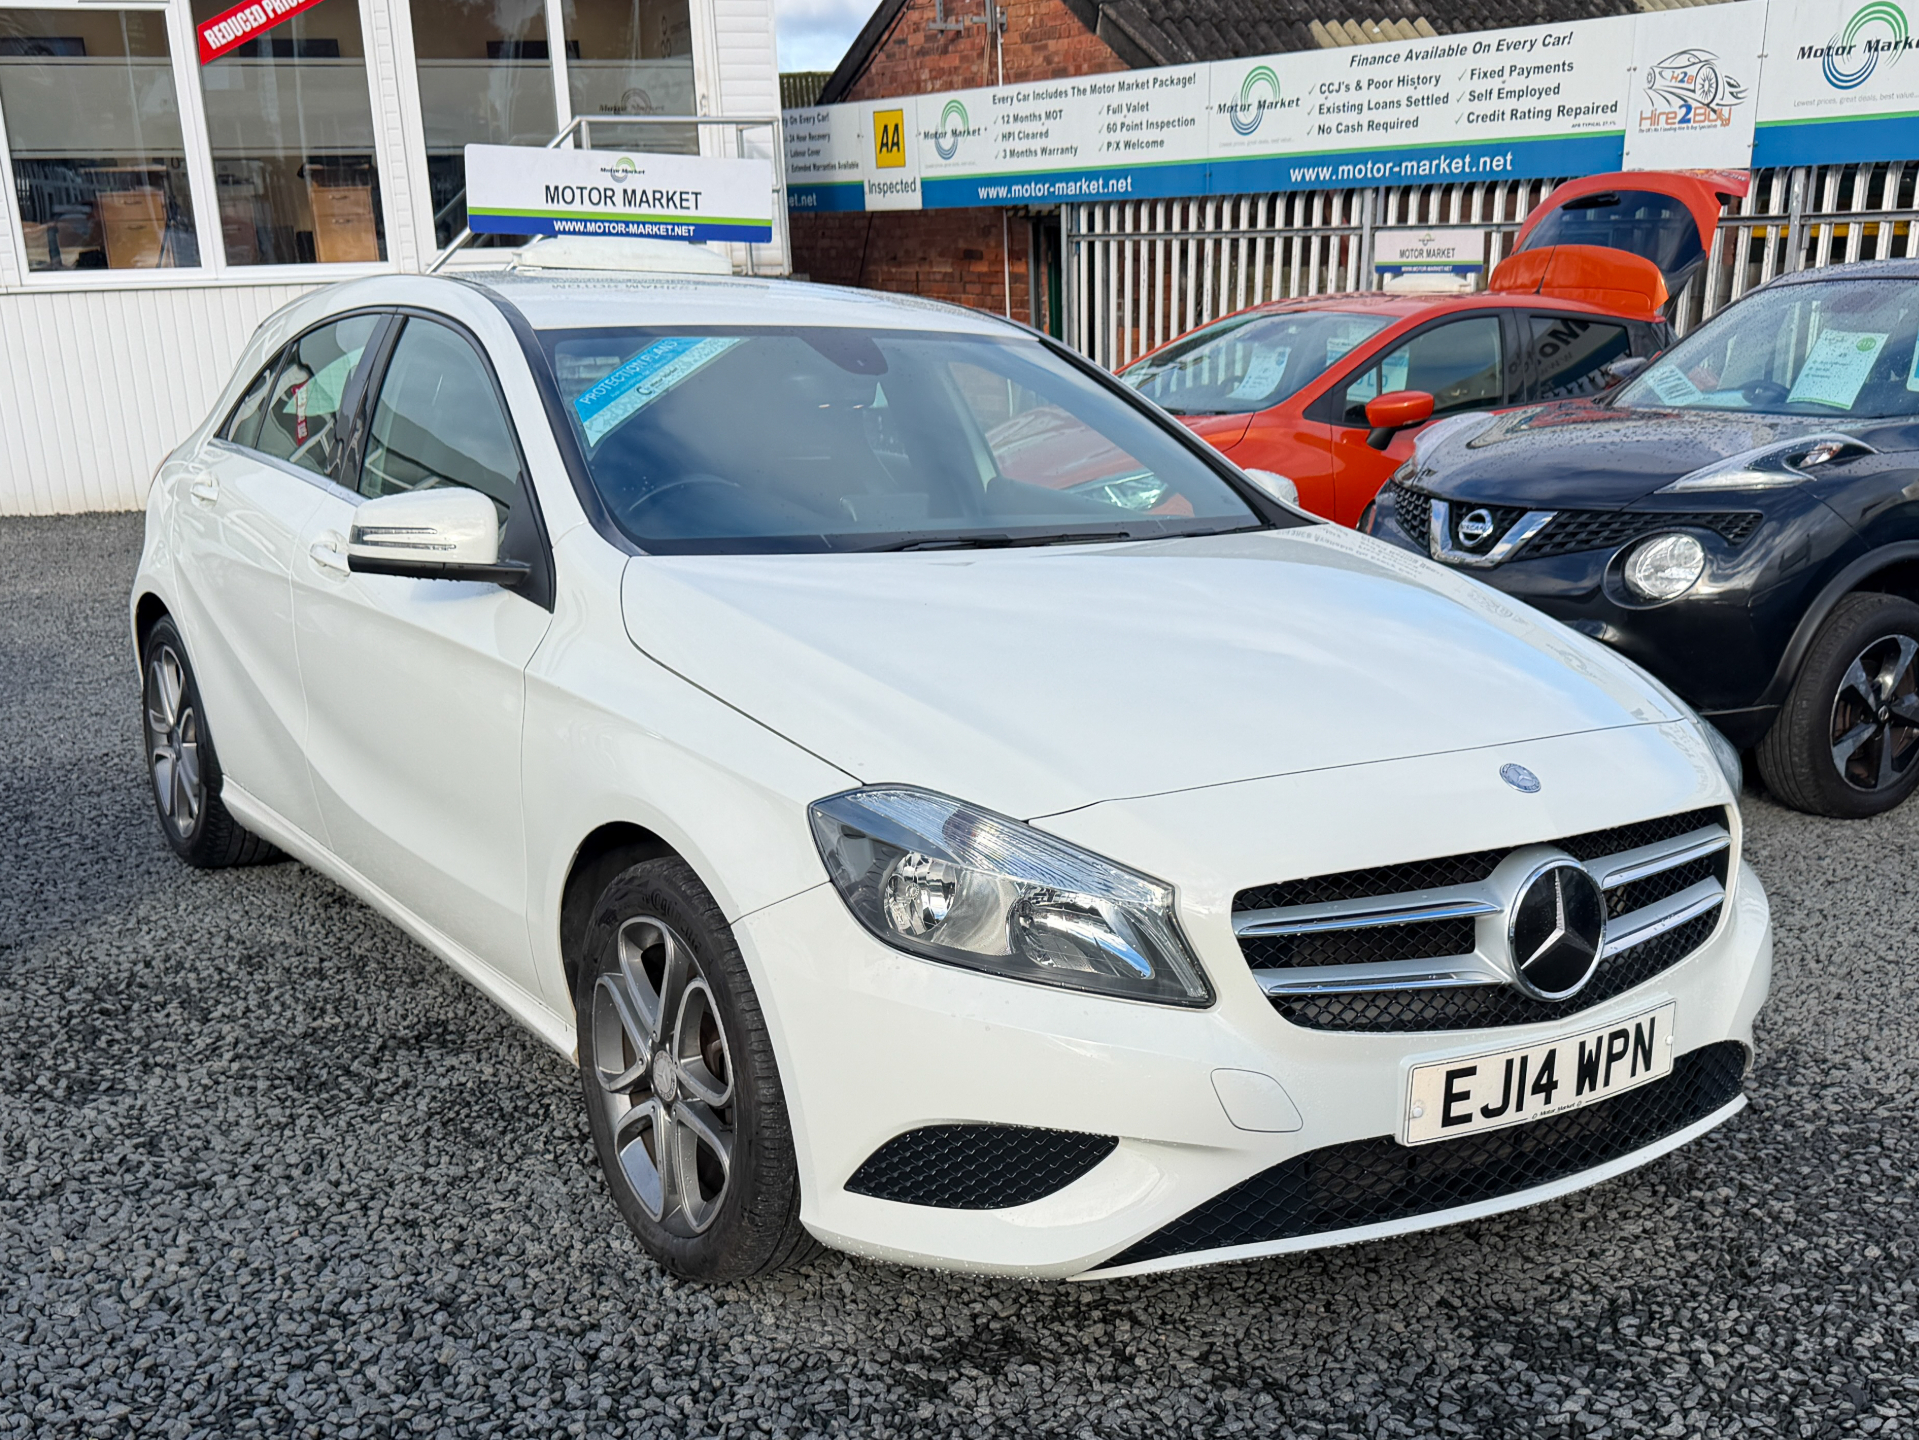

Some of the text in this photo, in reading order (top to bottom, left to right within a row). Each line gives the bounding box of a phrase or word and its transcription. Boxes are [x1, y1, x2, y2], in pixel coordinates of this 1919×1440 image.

[203, 4, 267, 50] REDUCED
[1350, 31, 1573, 68] Finance Available On Every Car!
[1796, 44, 1856, 60] Motor
[1470, 60, 1574, 81] Fixed Payments
[992, 74, 1196, 106] Every Car Includes The Motor Market Package!
[1319, 73, 1441, 95] CCJ's & Poor History
[1468, 83, 1560, 102] Self Employed
[1106, 102, 1149, 116] Full Valet
[1216, 97, 1300, 115] Motor Market
[1318, 92, 1450, 116] Existing Loans Settled
[1467, 100, 1618, 124] Credit Rating Repaired
[1001, 109, 1063, 125] 12 Months MOT
[1106, 116, 1196, 134] 60 Point Inspection
[1318, 116, 1419, 136] No Cash Required
[1639, 103, 1732, 128] Hire2Buy
[879, 123, 900, 154] AA
[924, 127, 981, 140] Motor Market
[1001, 129, 1049, 142] HPI Cleared
[1123, 138, 1164, 150] Welcome
[1002, 144, 1078, 159] 3 Months Warranty
[1290, 151, 1513, 182] www.motor-market.net
[545, 185, 702, 210] MOTOR MARKET
[868, 176, 916, 198] Inspected
[978, 175, 1132, 200] www.motor-market.net
[554, 220, 696, 236] WWW.MOTOR-MARKET.NET
[1399, 248, 1456, 259] MOTOR MARKET
[580, 356, 646, 405] PROTECTION
[1441, 1016, 1656, 1128] EJ14 WPN
